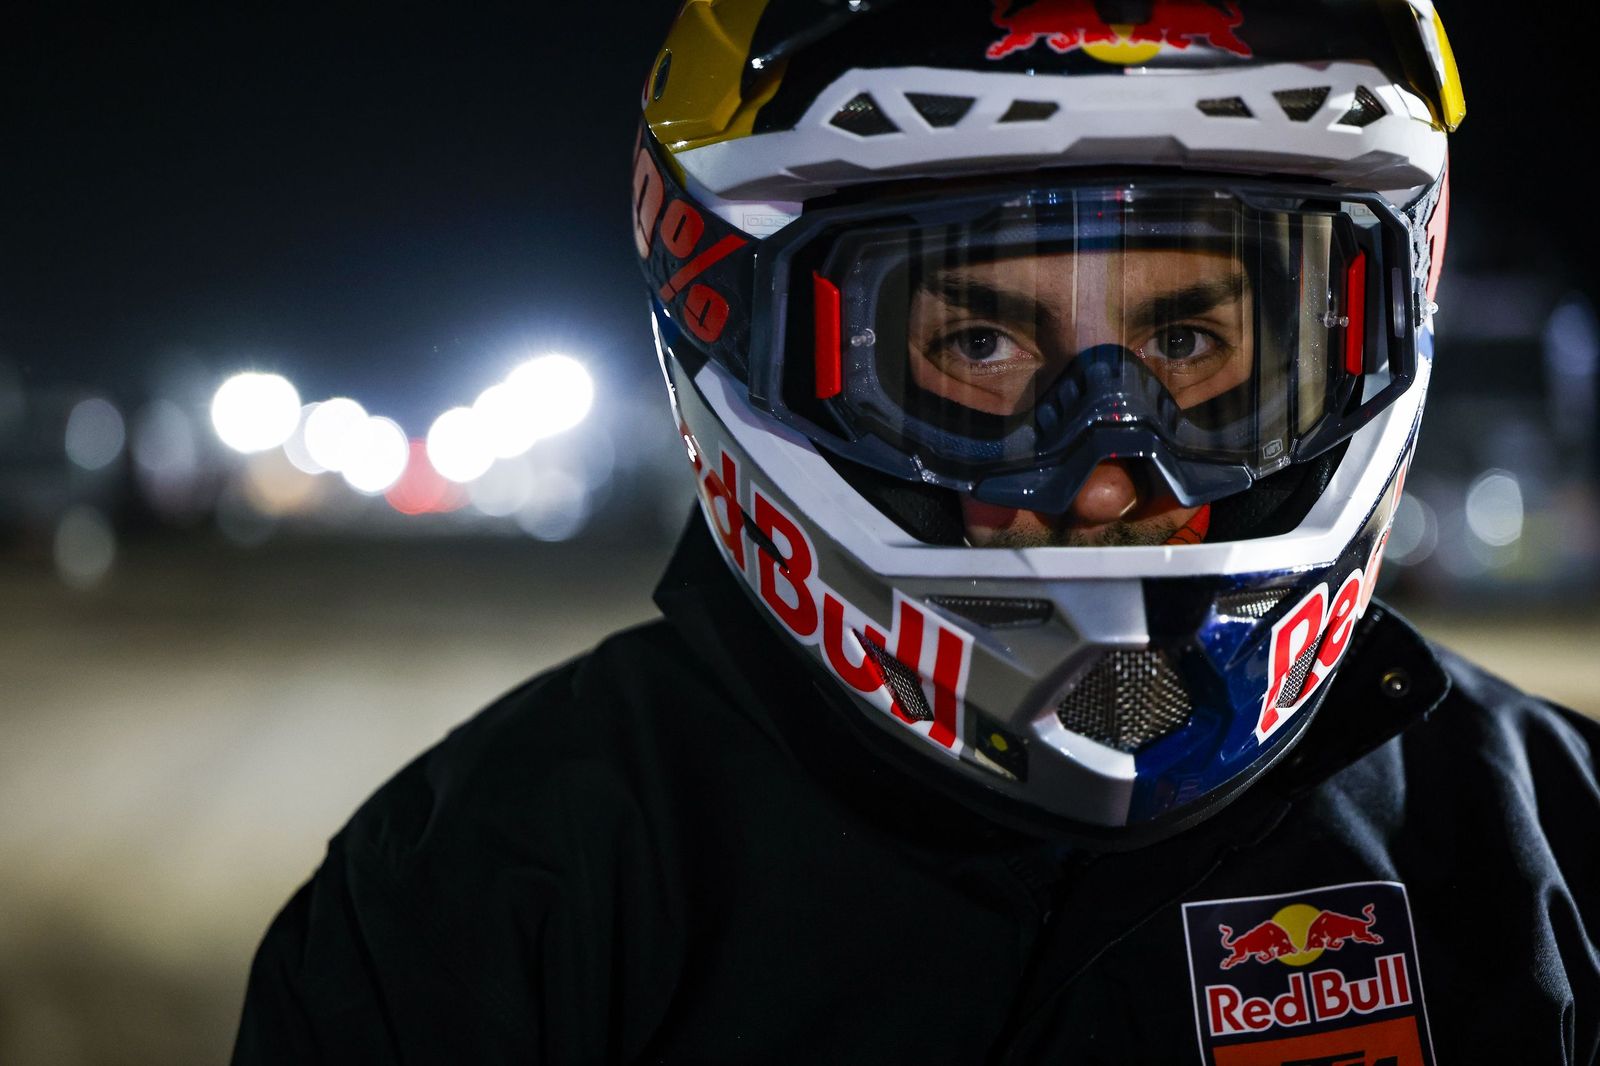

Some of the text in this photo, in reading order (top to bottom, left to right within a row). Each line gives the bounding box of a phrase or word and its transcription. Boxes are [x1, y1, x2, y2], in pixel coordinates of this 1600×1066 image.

[755, 490, 965, 750] Bull
[1208, 955, 1411, 1034] Red Bull
